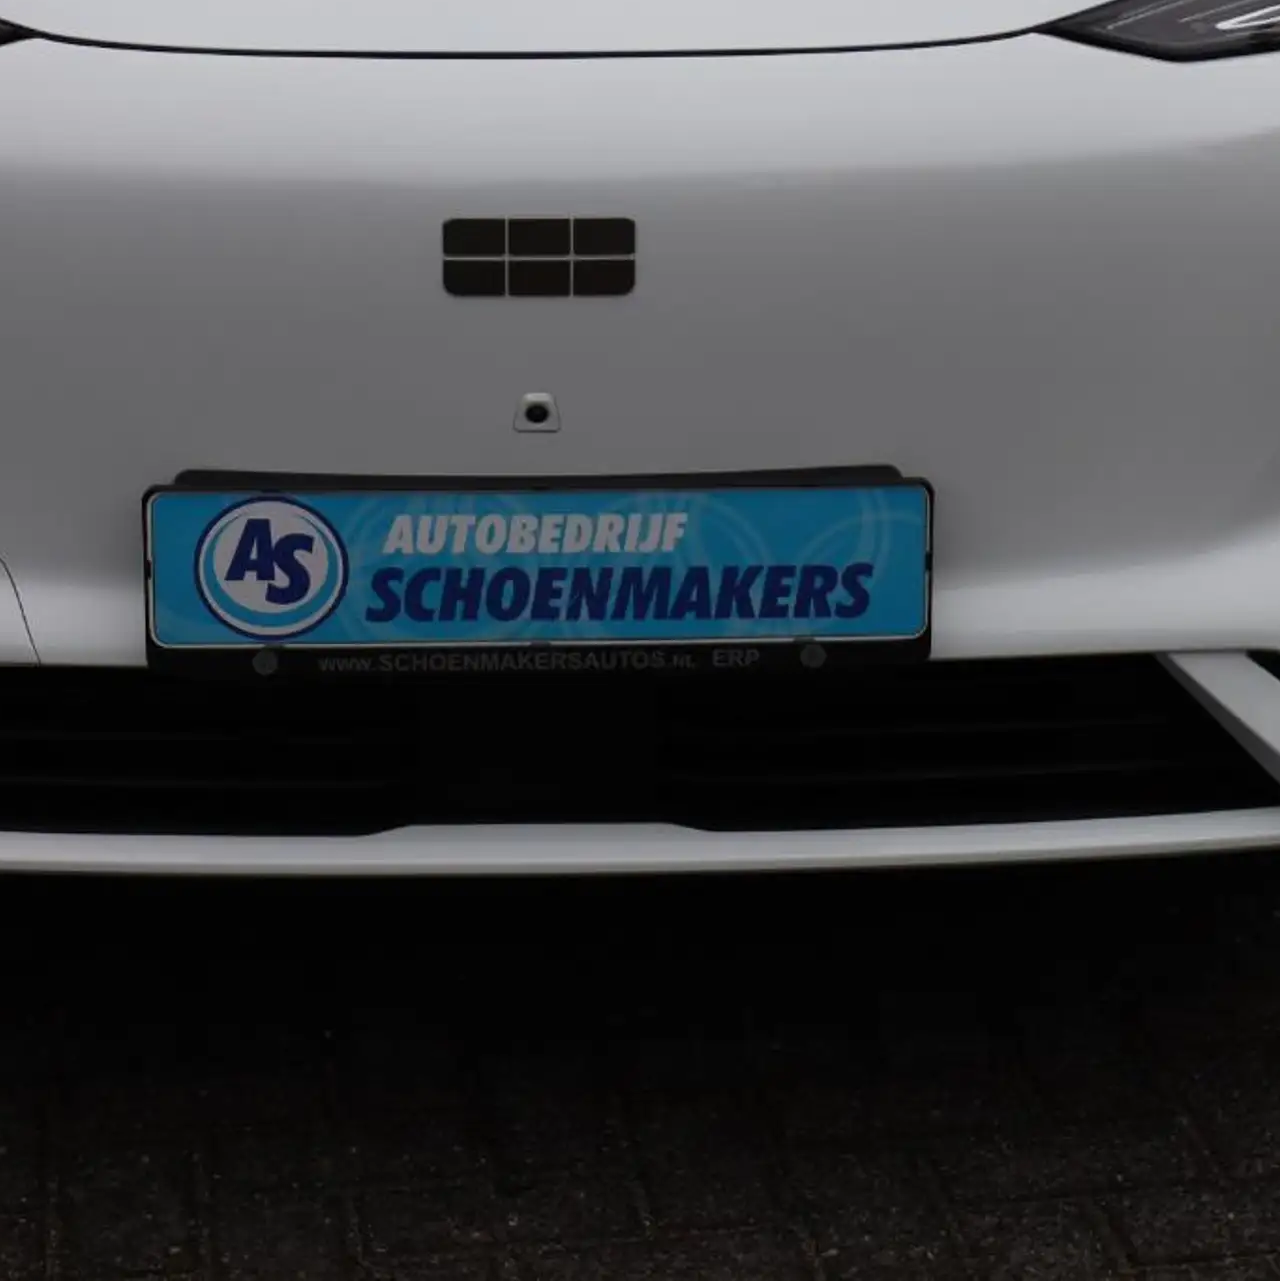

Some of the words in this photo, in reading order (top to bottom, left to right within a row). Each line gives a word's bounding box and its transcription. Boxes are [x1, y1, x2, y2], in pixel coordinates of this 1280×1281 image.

[382, 512, 688, 555] AUTOBEDRIJF
[225, 518, 314, 605] AS
[365, 563, 874, 622] SCHOENMAKERS
[711, 647, 761, 668] ERP
